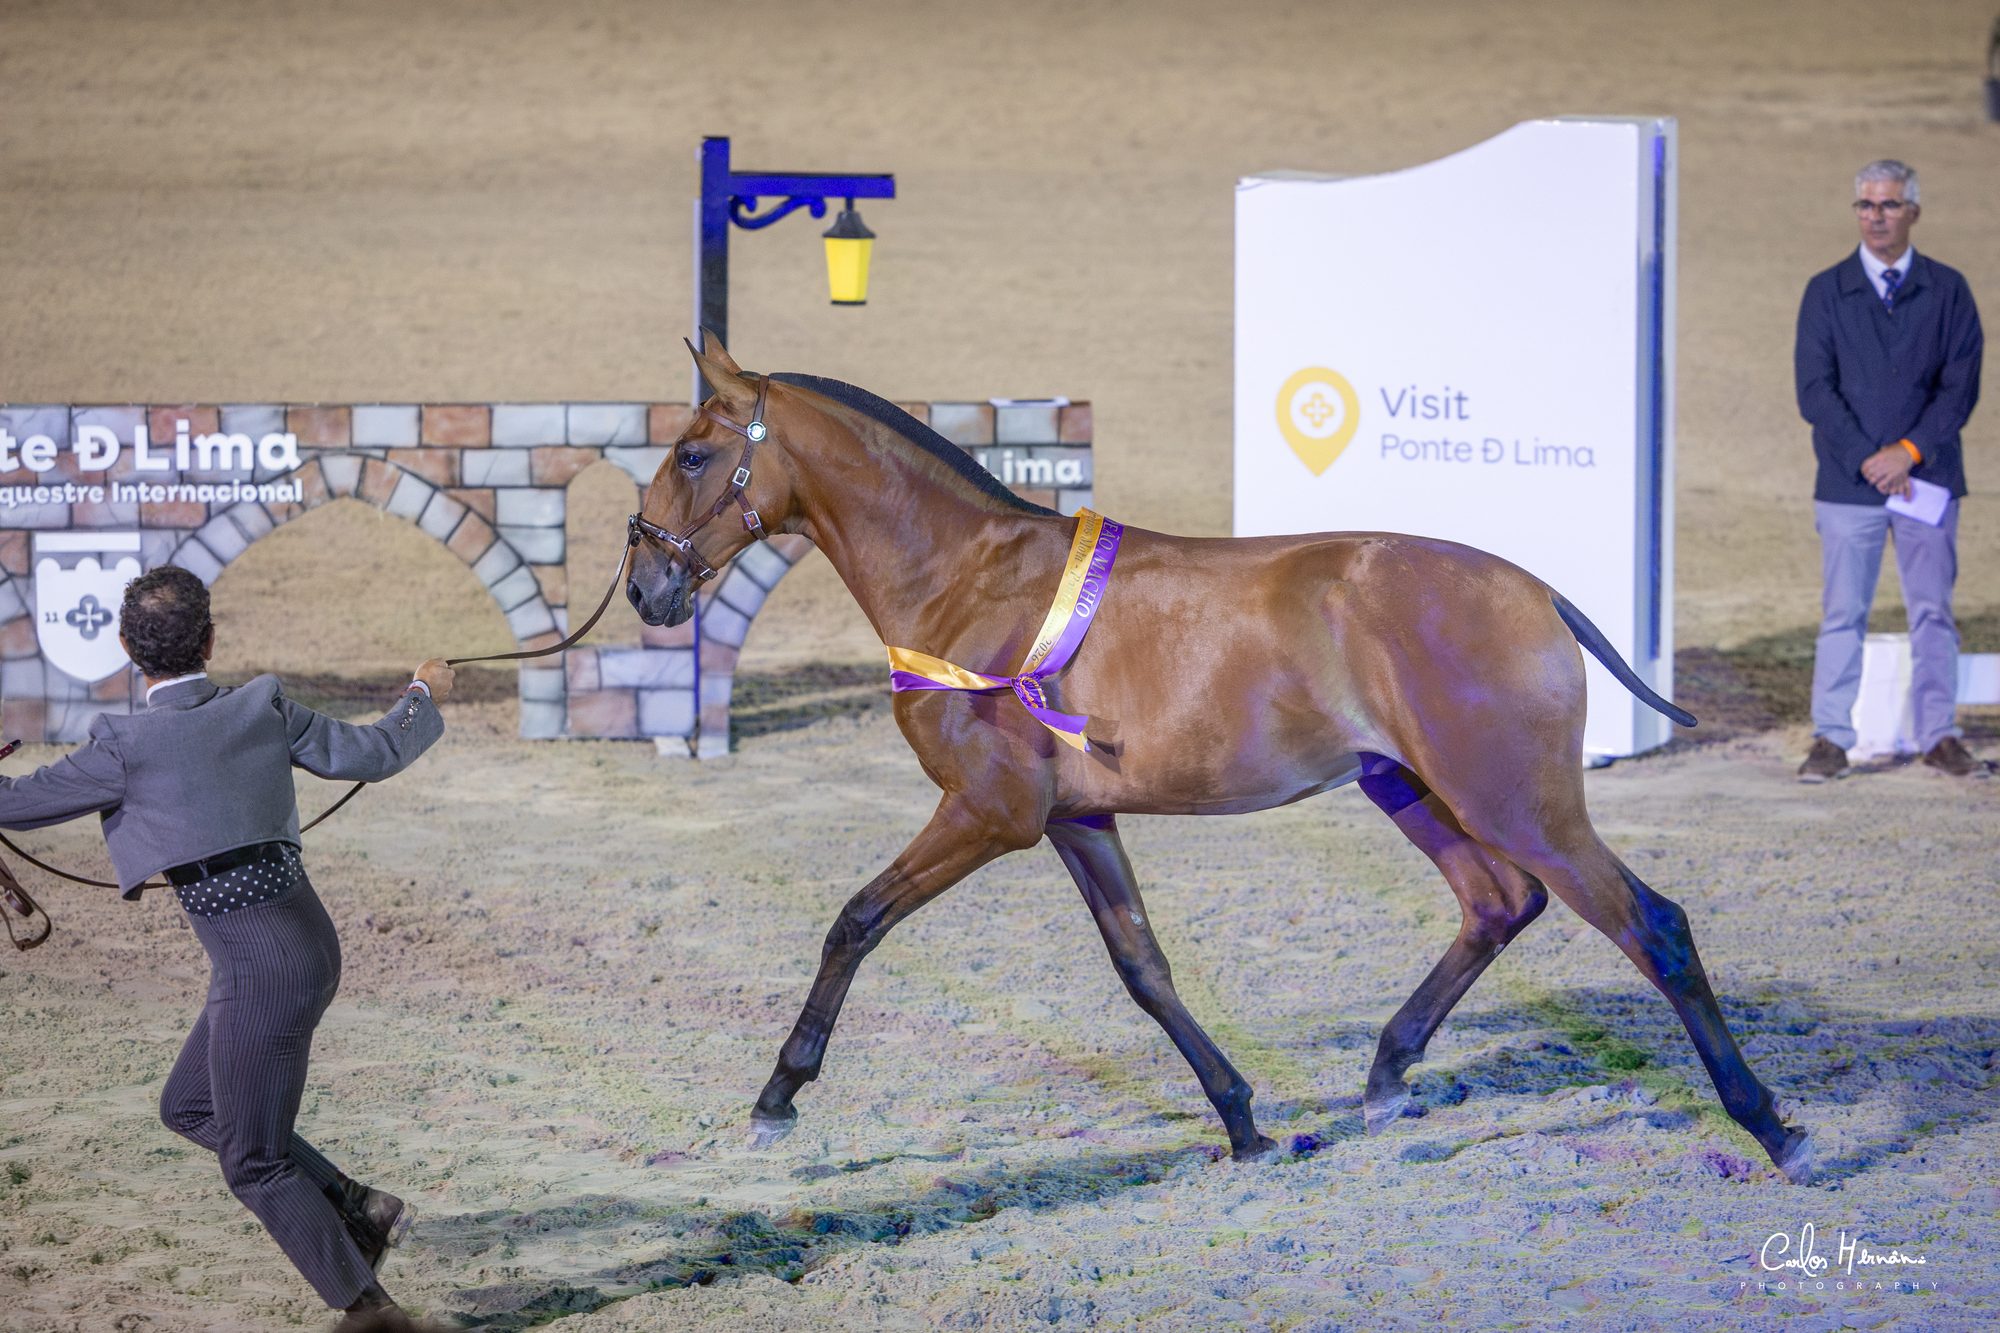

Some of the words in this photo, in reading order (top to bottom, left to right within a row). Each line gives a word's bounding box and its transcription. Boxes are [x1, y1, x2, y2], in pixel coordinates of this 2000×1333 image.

[1380, 385, 1470, 420] Visit
[134, 419, 301, 472] Lima
[1381, 434, 1473, 463] Ponte
[1514, 437, 1596, 468] Lima
[112, 478, 303, 503] Internacional
[1075, 553, 1109, 618] MACHO
